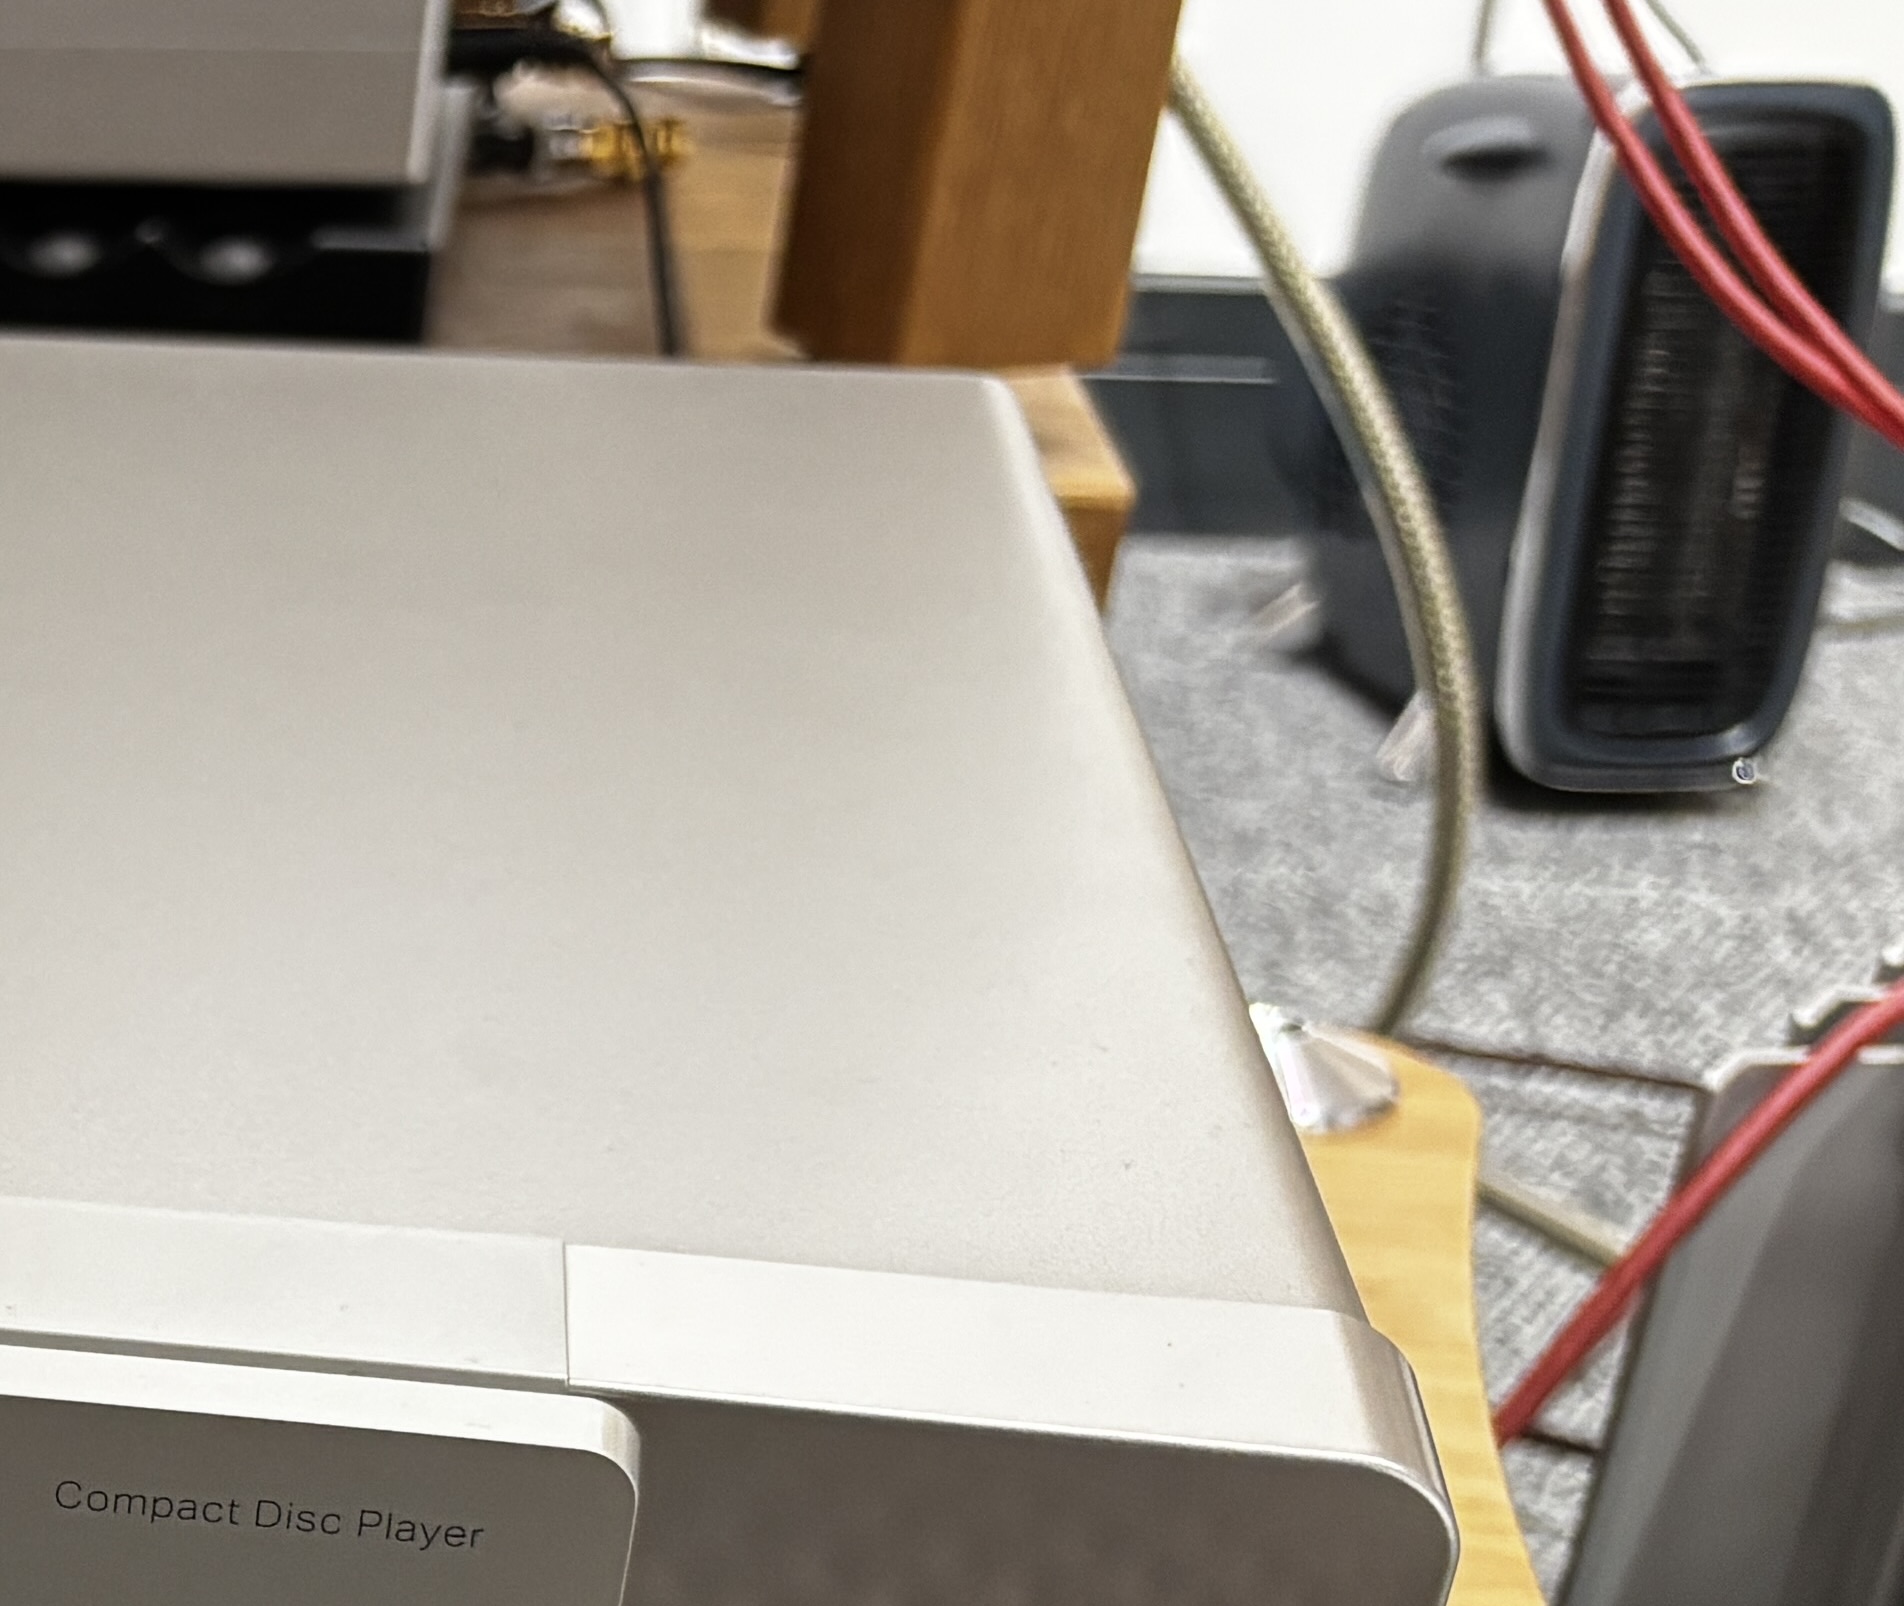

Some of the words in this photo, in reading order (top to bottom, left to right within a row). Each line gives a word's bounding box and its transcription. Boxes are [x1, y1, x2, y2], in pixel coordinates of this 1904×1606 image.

[54, 1480, 240, 1525] Compact
[254, 1498, 342, 1536] Disc
[357, 1508, 485, 1551] Player
